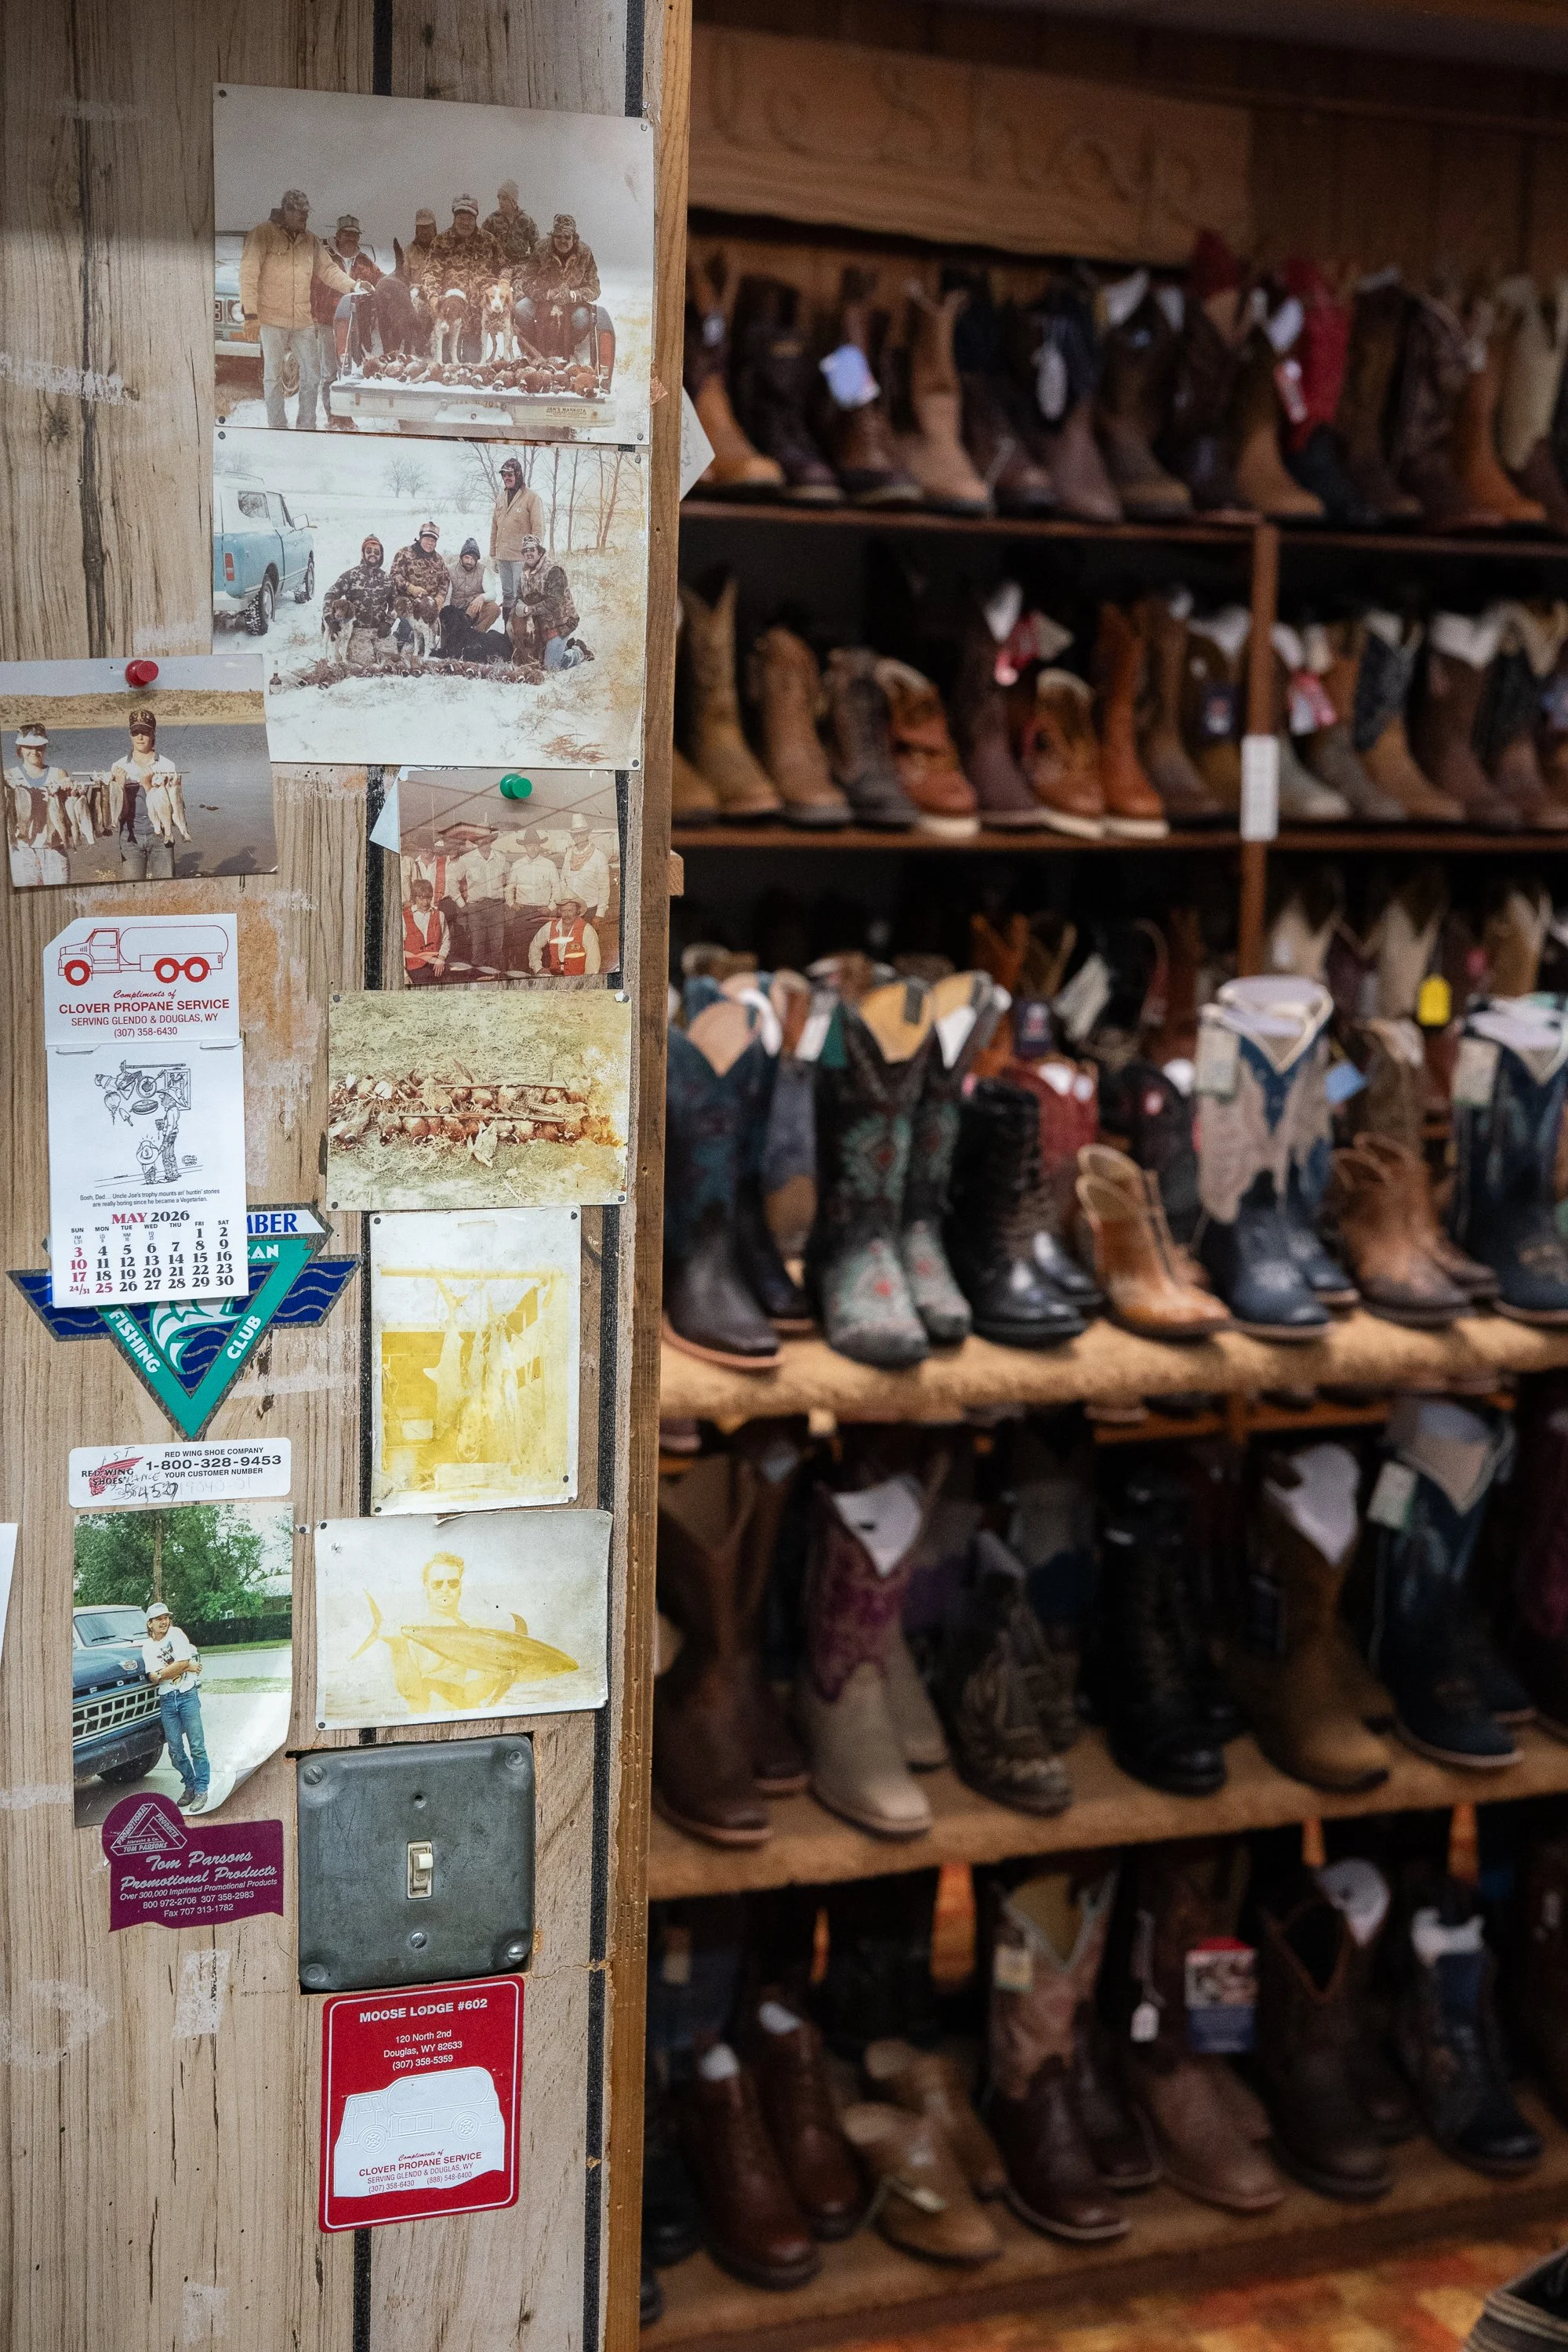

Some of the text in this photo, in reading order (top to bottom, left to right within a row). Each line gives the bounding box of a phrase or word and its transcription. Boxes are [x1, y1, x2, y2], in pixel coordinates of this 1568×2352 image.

[113, 989, 176, 1000] Compliments of
[59, 1000, 230, 1014] CLOVER PROPANE SERVICE
[71, 1017, 109, 1025] SERVING
[112, 1016, 147, 1025] GLENDO
[160, 1014, 203, 1023] DOUGLAS,
[114, 1027, 177, 1037] (307) 358-6430
[111, 1210, 191, 1225] MAY 2026
[197, 1226, 228, 1239] 1 2
[74, 1239, 229, 1258] 3 4 5 6 7 8 9
[247, 1244, 278, 1259] AN
[70, 1251, 233, 1270] 10 11 12 13 14 15 16
[71, 1263, 233, 1283] 17 18 19 20 21 22 23
[69, 1276, 234, 1295] 24/31 25 26 27 28 29 30
[108, 1308, 160, 1373] FISHING
[227, 1315, 262, 1359] CLUB
[146, 1455, 282, 1471] 1-800-328-9453
[93, 1477, 123, 1486] SHOES
[183, 1469, 230, 1478] CUSTOMER
[116, 1806, 148, 1846] PROMOTIONAL
[155, 1813, 180, 1838] PRODUCTS
[138, 1842, 168, 1851] PARSONS
[146, 1850, 252, 1871] Tom Parsons
[121, 1865, 278, 1891] Promotional Products
[139, 1890, 168, 1900] 300,000
[169, 1886, 202, 1896] Imprinted
[204, 1882, 245, 1893] Promotional
[247, 1878, 278, 1888] Products
[160, 1897, 197, 1907] 972-2706
[218, 1891, 255, 1901] 358-2983
[197, 1904, 234, 1914] 313-1782
[359, 1998, 488, 2023] MOOSE LODGE #602
[412, 2031, 434, 2042] North
[436, 2029, 452, 2038] 2nd
[383, 2041, 463, 2058] Douglas, WY 82633
[393, 2055, 454, 2071] (307) 358-5359
[359, 2151, 482, 2177] CLOVER PROPANE SERVICE
[398, 2151, 436, 2161] Compliments
[367, 2174, 395, 2184] SERVING
[396, 2169, 423, 2180] GLENDO
[430, 2165, 461, 2175] DOUGLAS,
[368, 2171, 473, 2194] (307) 358-6430 (888) 548-6400
